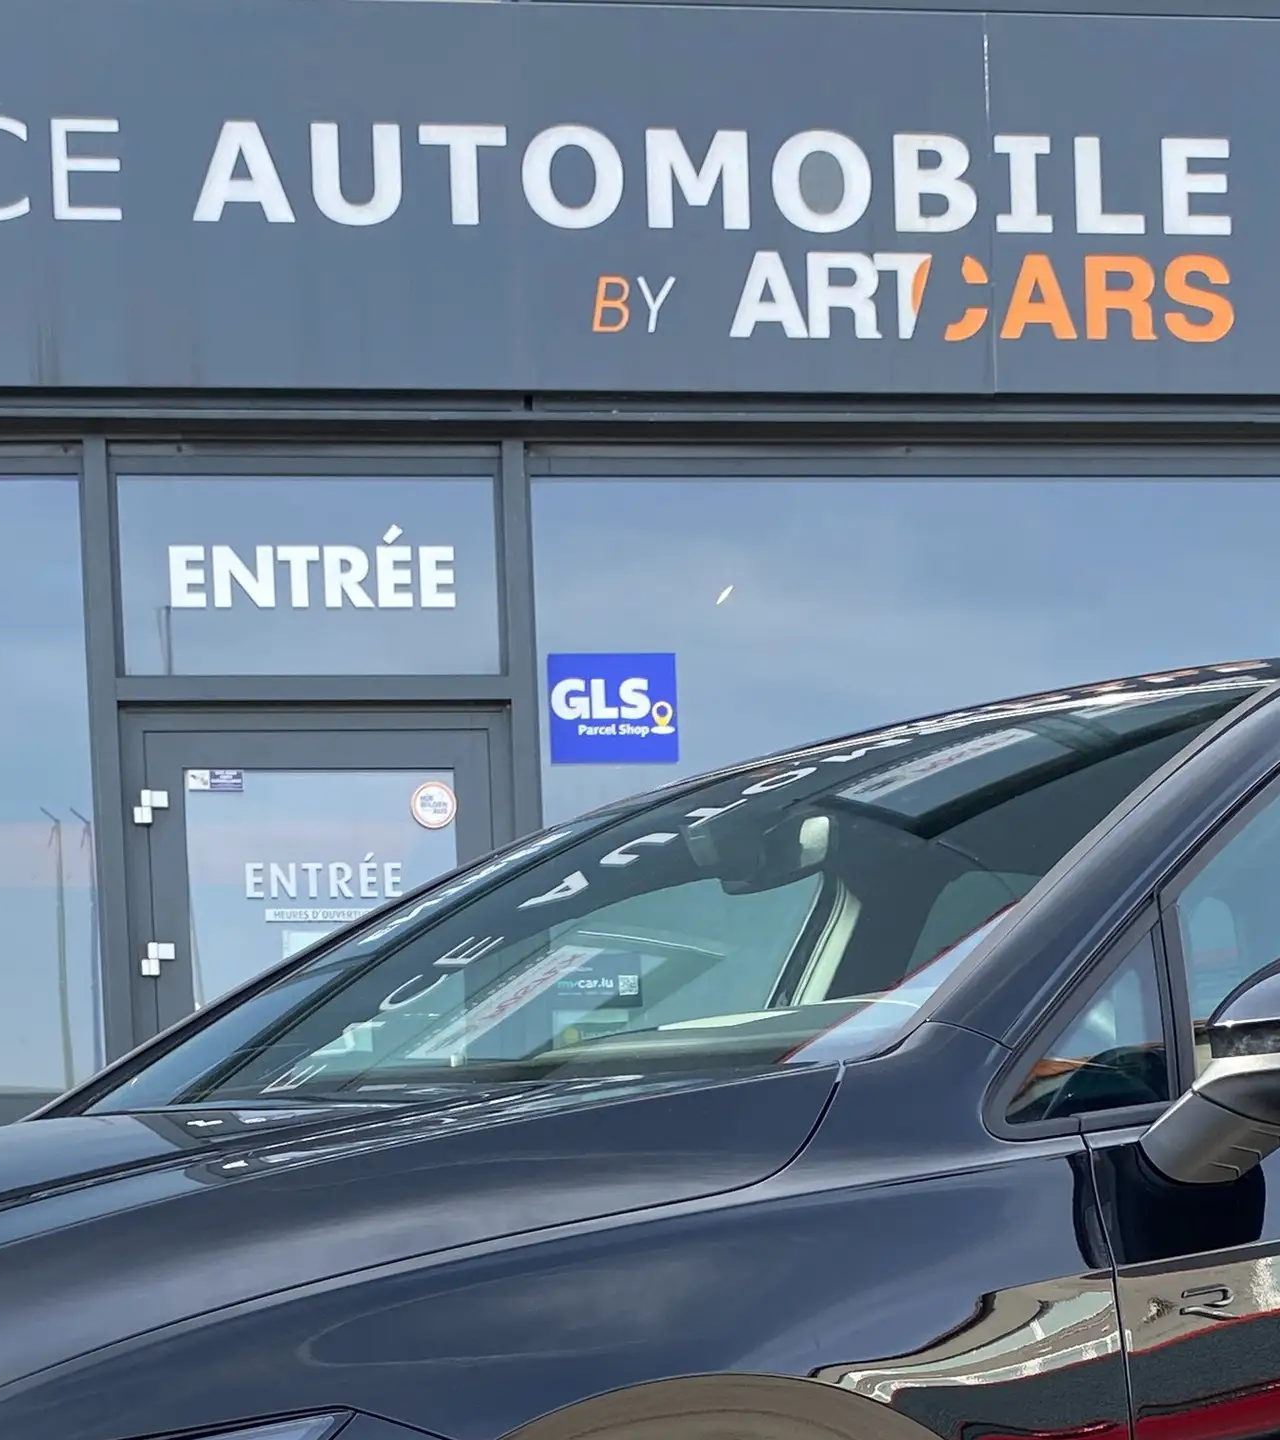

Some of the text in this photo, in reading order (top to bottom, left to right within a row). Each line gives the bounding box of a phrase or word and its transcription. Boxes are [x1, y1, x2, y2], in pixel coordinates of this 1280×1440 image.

[193, 121, 1232, 235] AUTOMOBILE
[592, 251, 1234, 343] BY ARTCARS
[168, 524, 456, 608] ENTRÉE
[551, 677, 651, 720] GLS
[578, 723, 650, 738] Parcel Shop
[245, 852, 403, 899] ENTRÉE
[273, 910, 370, 920] HEURES D'OUVERTU
